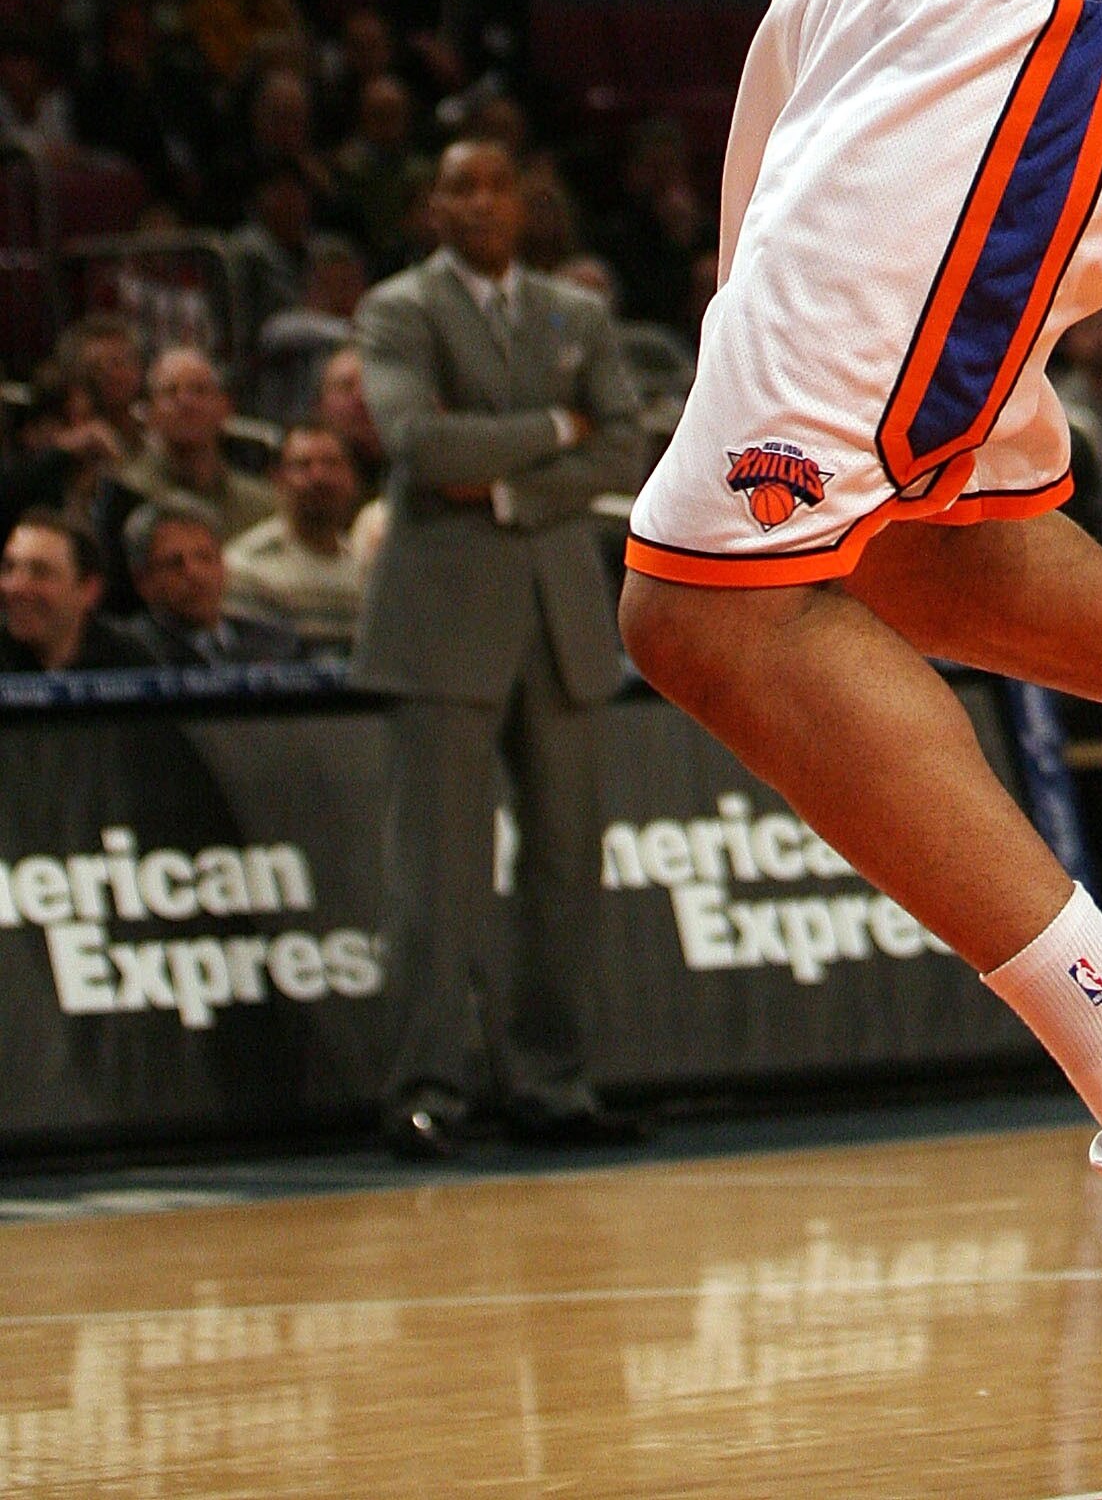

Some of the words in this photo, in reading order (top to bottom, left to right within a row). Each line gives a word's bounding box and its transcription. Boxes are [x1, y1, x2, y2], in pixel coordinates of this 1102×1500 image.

[726, 447, 825, 507] KNICKS
[0, 825, 314, 930] erican
[44, 920, 392, 1031] Expres
[669, 882, 955, 985] Expre
